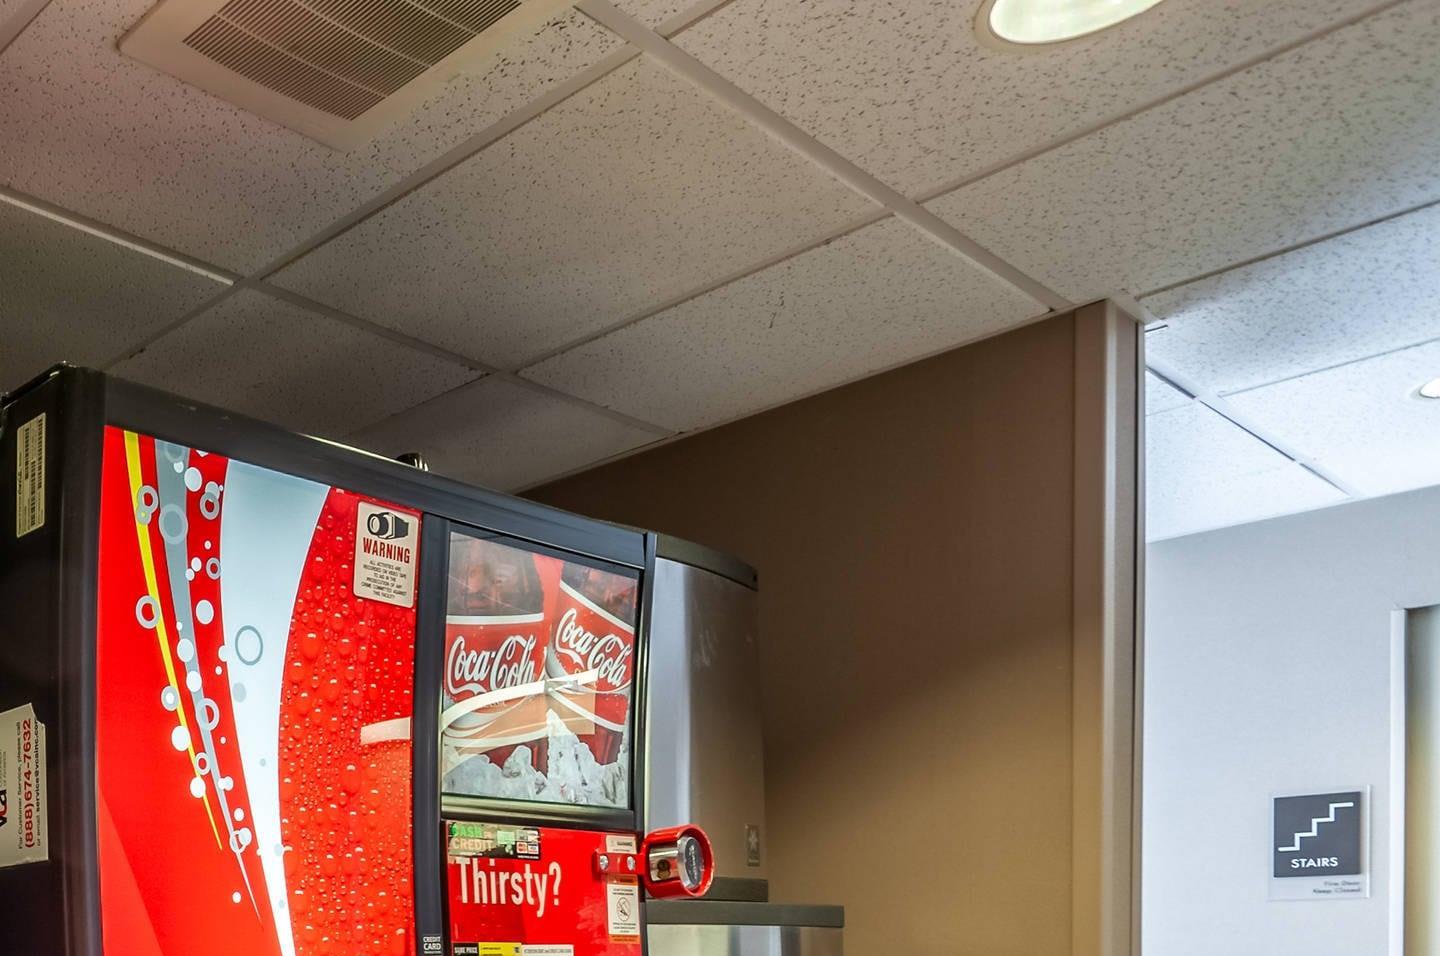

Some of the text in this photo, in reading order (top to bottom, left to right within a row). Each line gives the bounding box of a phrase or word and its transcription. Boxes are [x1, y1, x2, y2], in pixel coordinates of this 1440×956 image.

[362, 536, 411, 564] WARNING
[447, 634, 537, 694] Coca-Cola
[555, 607, 632, 688] Coca-Cola
[1291, 856, 1339, 869] STAIRS
[455, 857, 561, 917] Thirsty?
[423, 942, 441, 951] CARD
